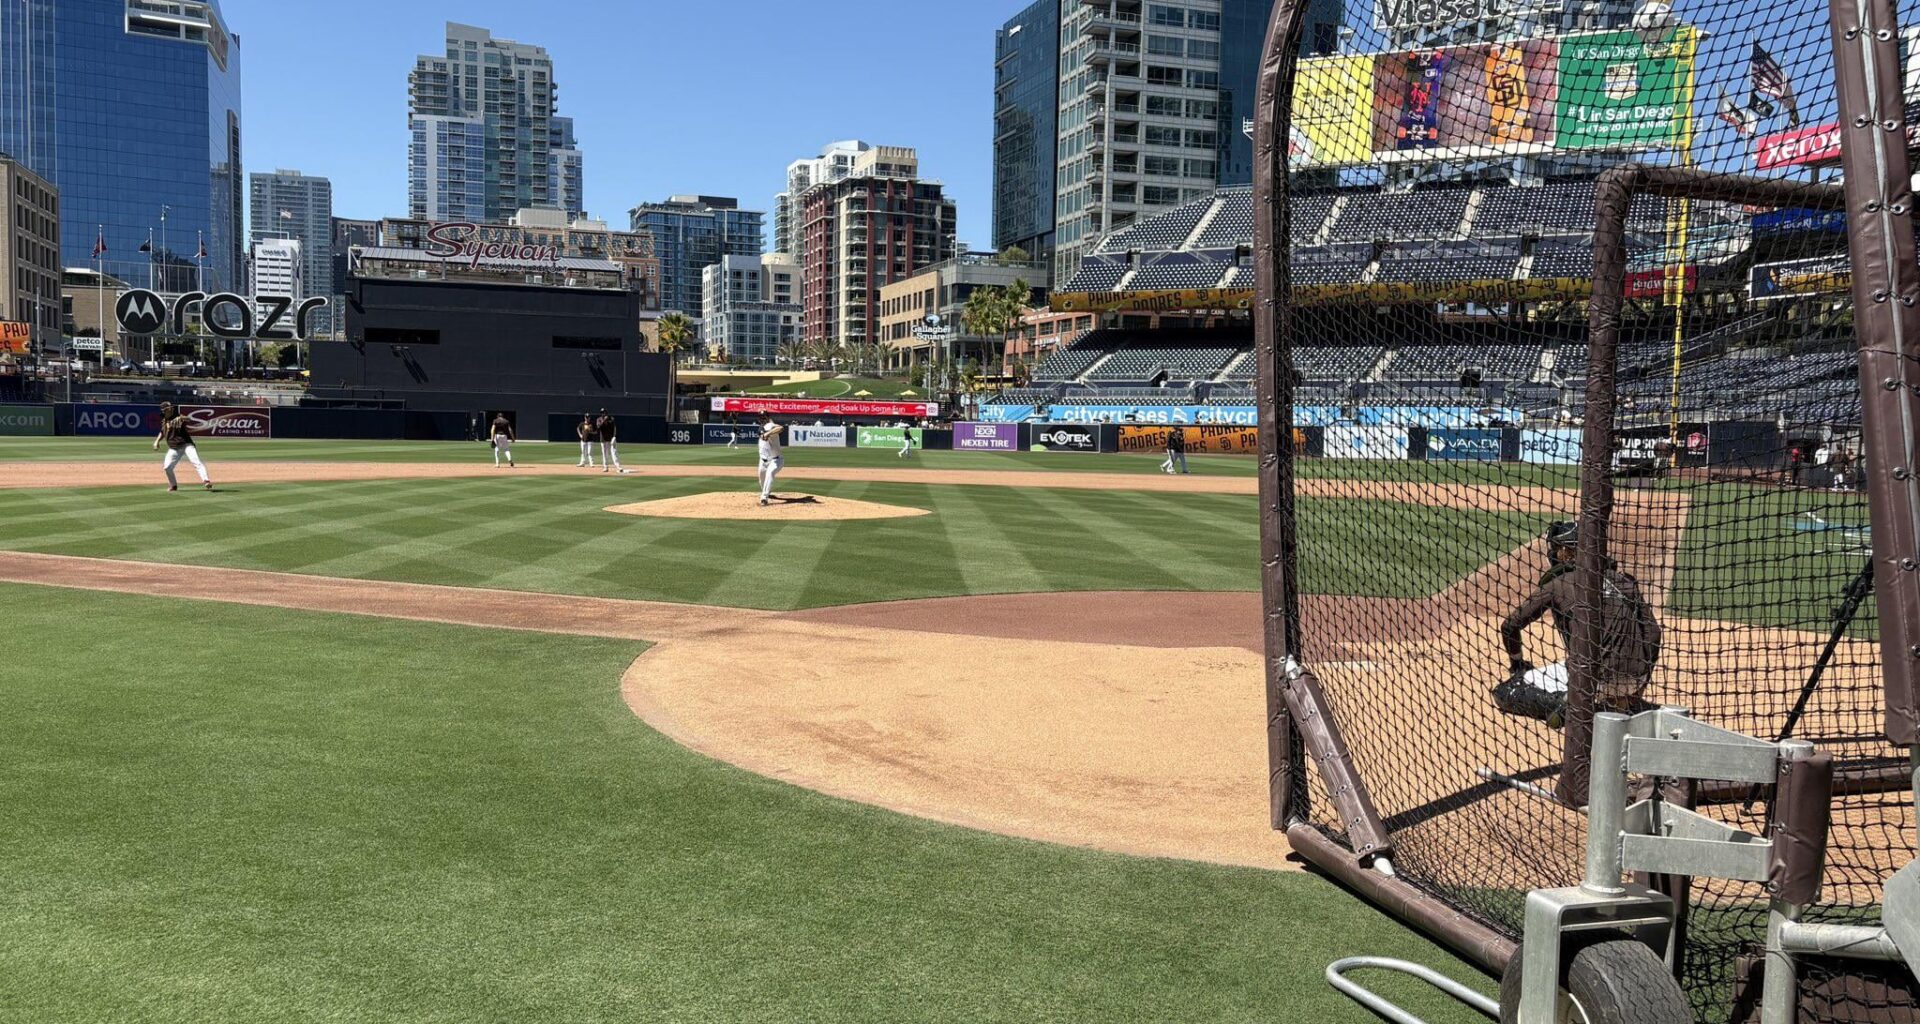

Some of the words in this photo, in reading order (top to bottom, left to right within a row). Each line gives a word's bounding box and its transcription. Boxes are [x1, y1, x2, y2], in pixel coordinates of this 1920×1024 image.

[1378, 0, 1501, 26] Viasat
[1605, 108, 1631, 121] San
[1634, 106, 1674, 119] Diego
[425, 222, 561, 269] Sycuan
[172, 291, 327, 340] razr
[780, 402, 820, 411] Excitement
[860, 404, 870, 412] Up
[1063, 402, 1168, 424] citycruses
[78, 412, 140, 428] ARCO
[186, 409, 262, 434] Sycuan
[671, 430, 690, 442] 396
[809, 430, 842, 438] National
[1040, 430, 1091, 445] EVOTEK
[1122, 431, 1168, 449] PADRES
[961, 439, 988, 447] NEXEN
[990, 439, 1009, 448] TIRE
